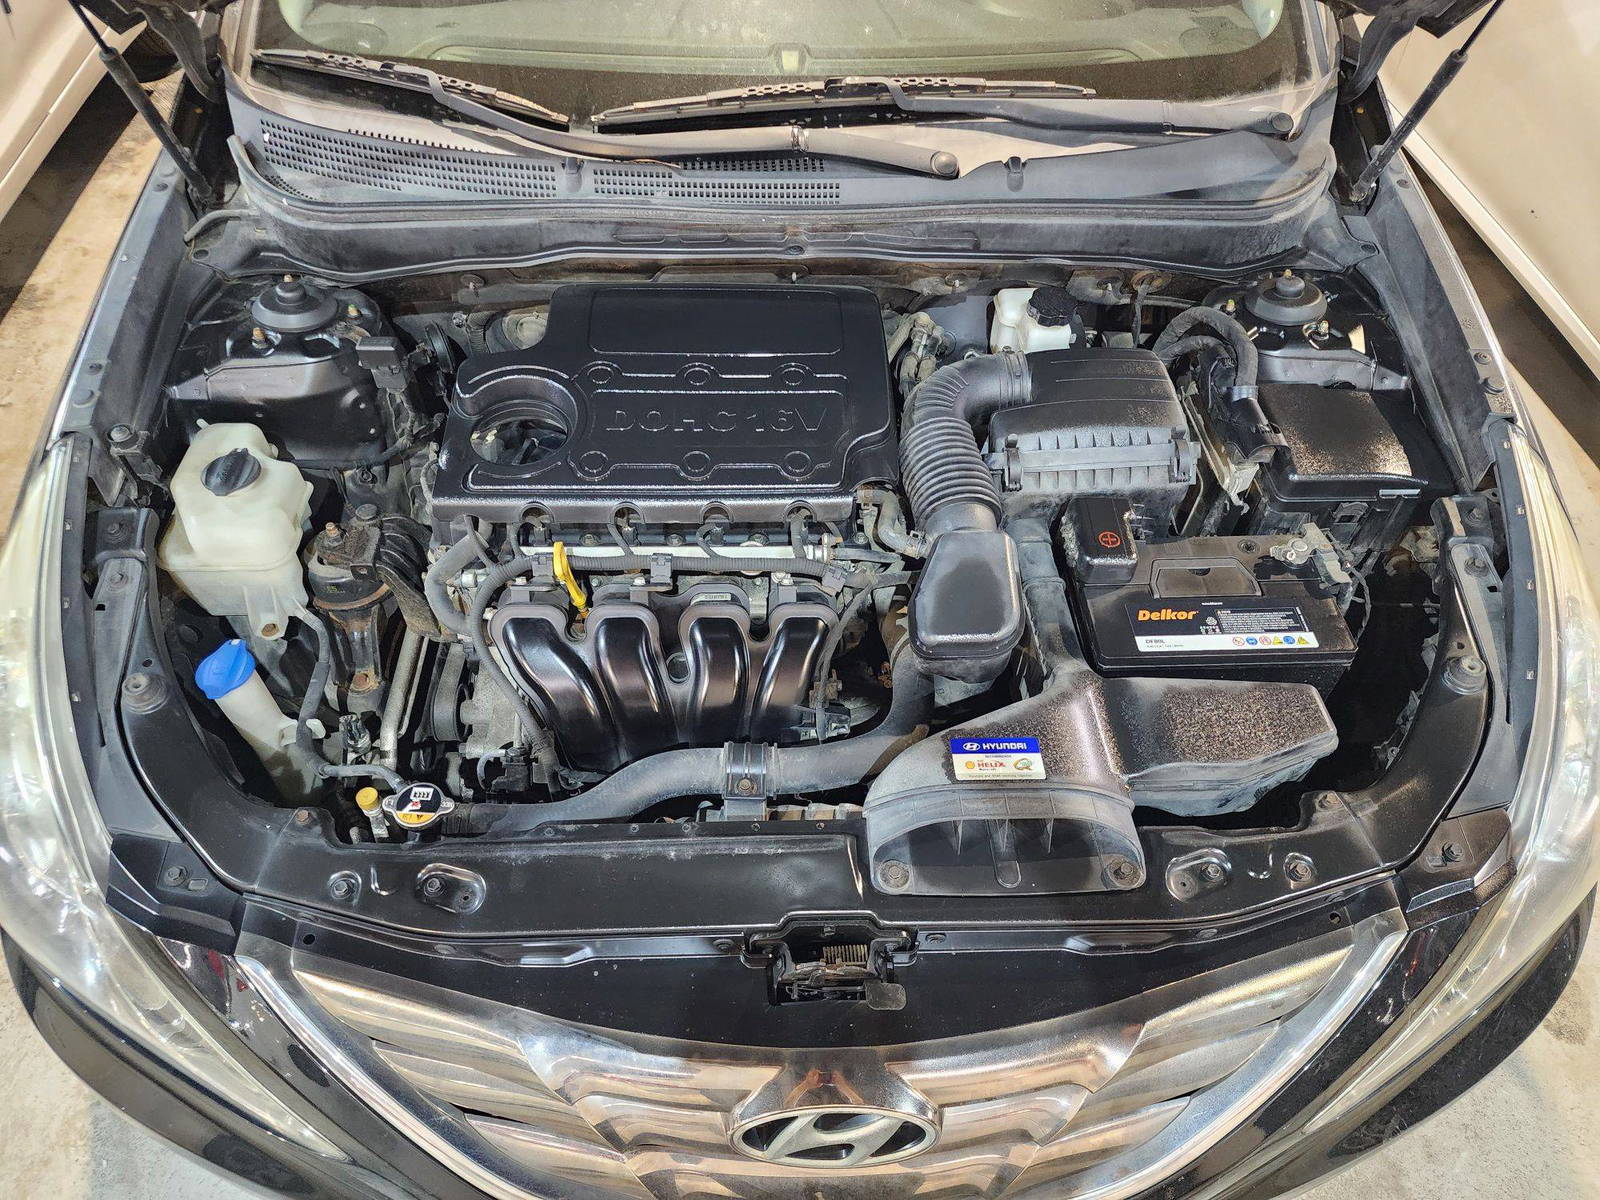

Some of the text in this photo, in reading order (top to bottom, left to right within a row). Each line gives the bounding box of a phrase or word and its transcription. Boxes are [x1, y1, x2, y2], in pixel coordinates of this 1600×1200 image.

[605, 407, 827, 431] DOHC 16V
[1138, 609, 1197, 620] Delkor
[982, 742, 1027, 750] HYUNDAI
